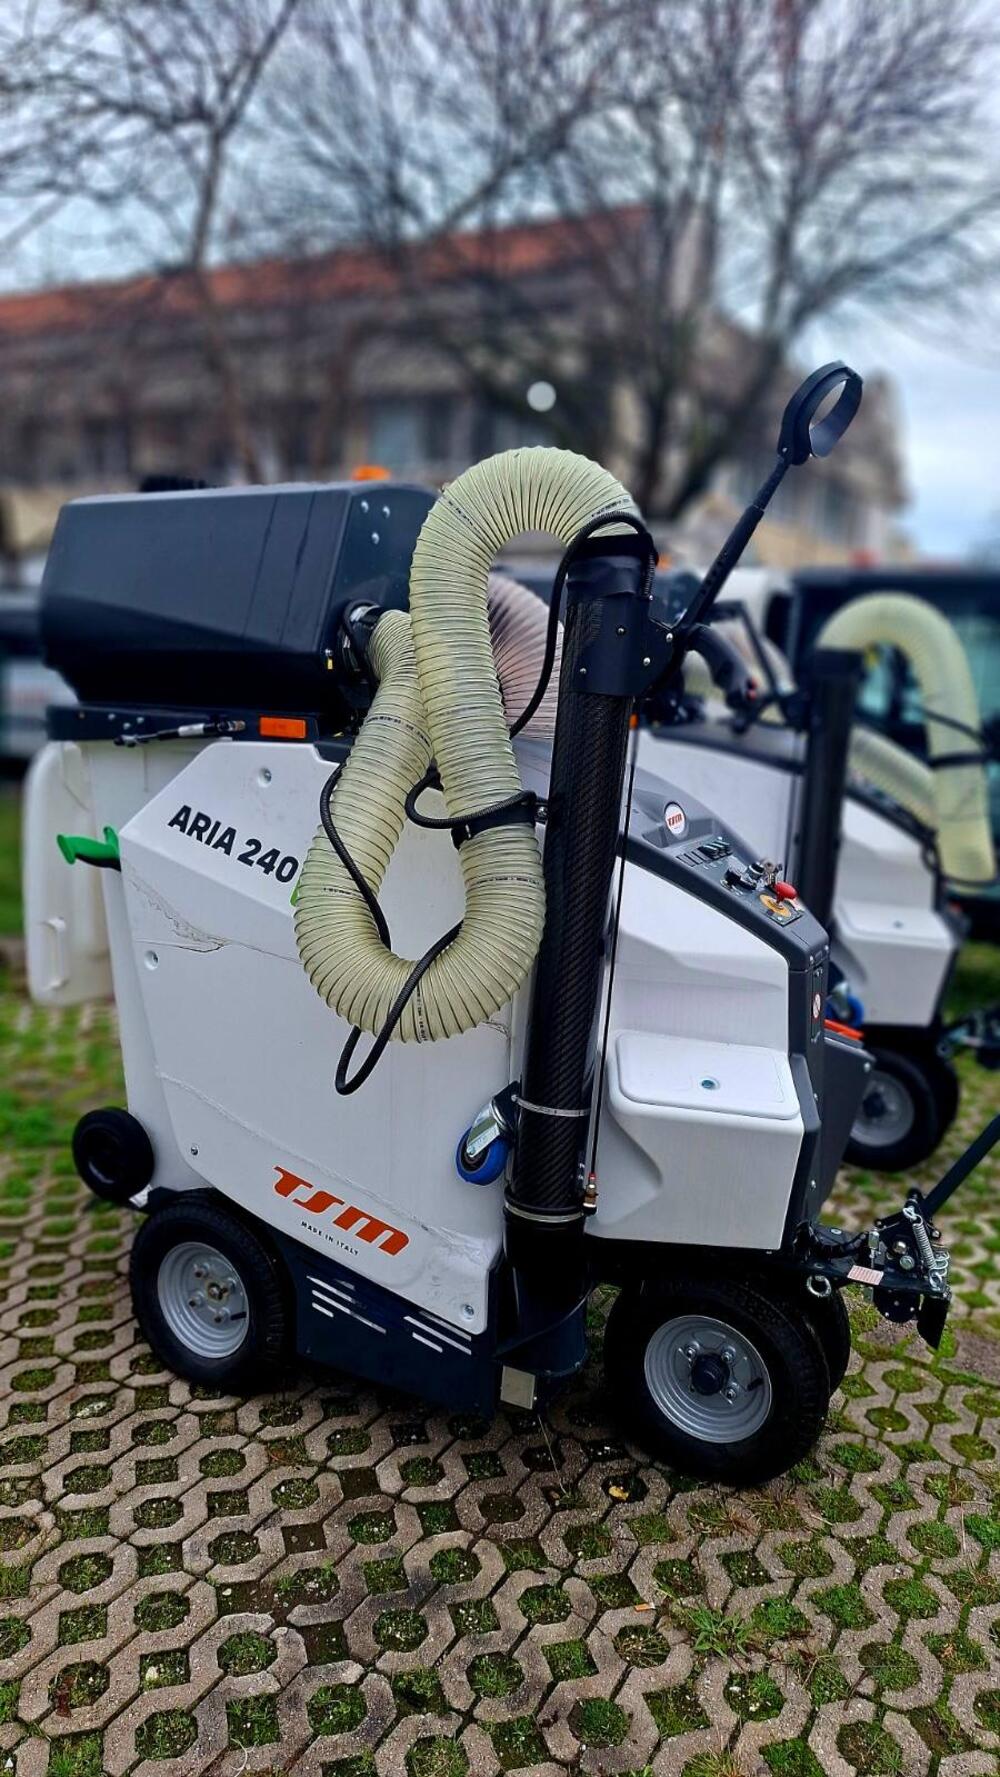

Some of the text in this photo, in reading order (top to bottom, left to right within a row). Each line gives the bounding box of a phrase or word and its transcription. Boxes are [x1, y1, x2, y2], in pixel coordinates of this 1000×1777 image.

[167, 804, 299, 883] ARIA 240
[273, 1165, 410, 1256] TSM
[301, 1220, 359, 1256] MADE IN ITALY
